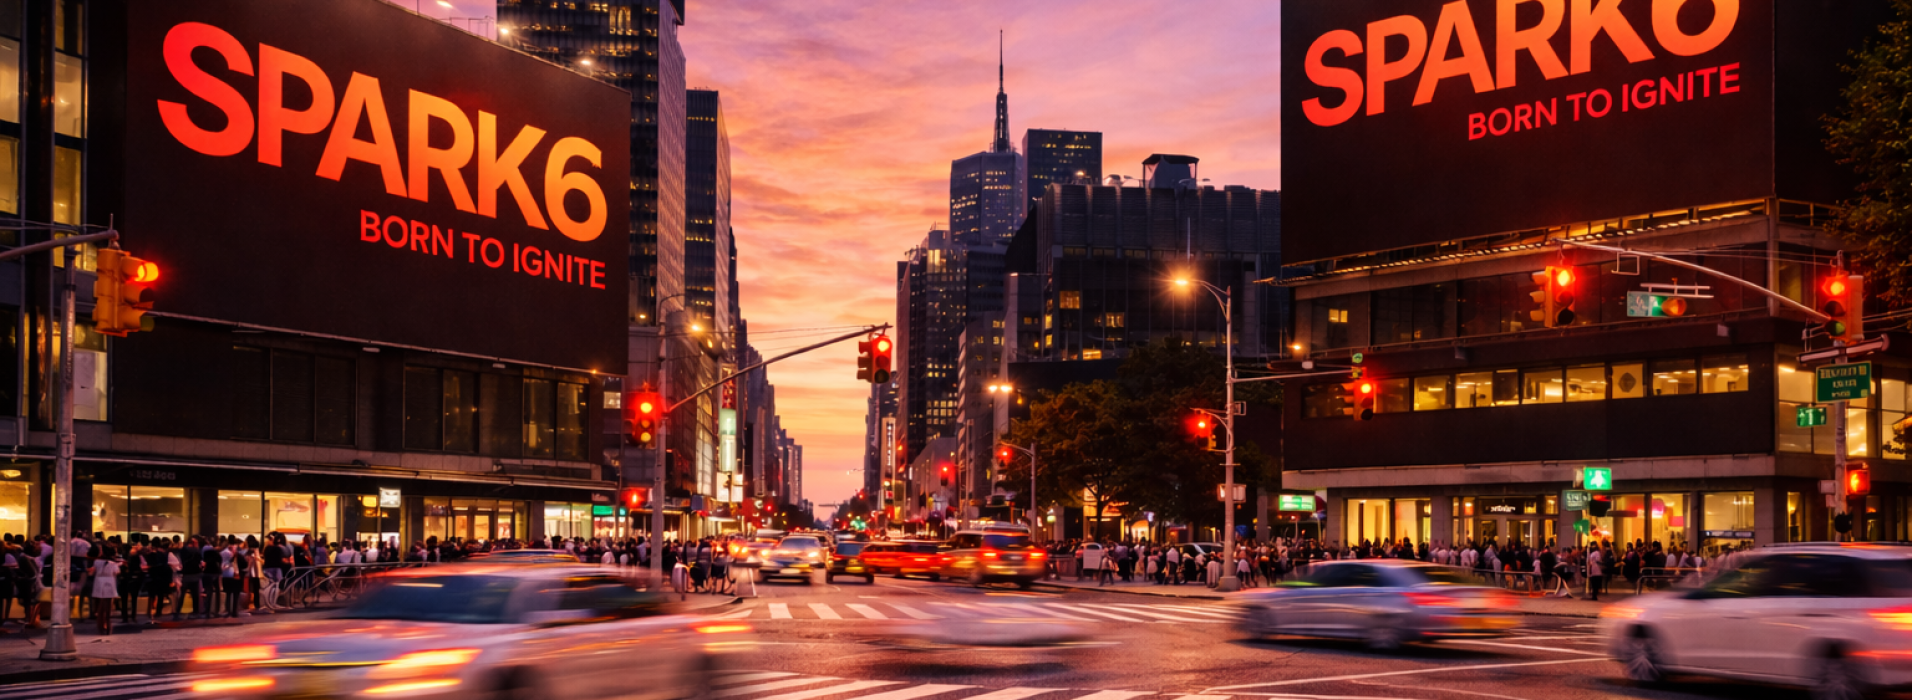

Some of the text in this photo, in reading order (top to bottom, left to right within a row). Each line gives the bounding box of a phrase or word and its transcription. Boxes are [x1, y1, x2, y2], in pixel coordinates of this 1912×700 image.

[157, 21, 608, 242] SPARK6
[1469, 62, 1741, 141] BORN TO IGNITE
[360, 209, 606, 290] BORN TO IGNITE
